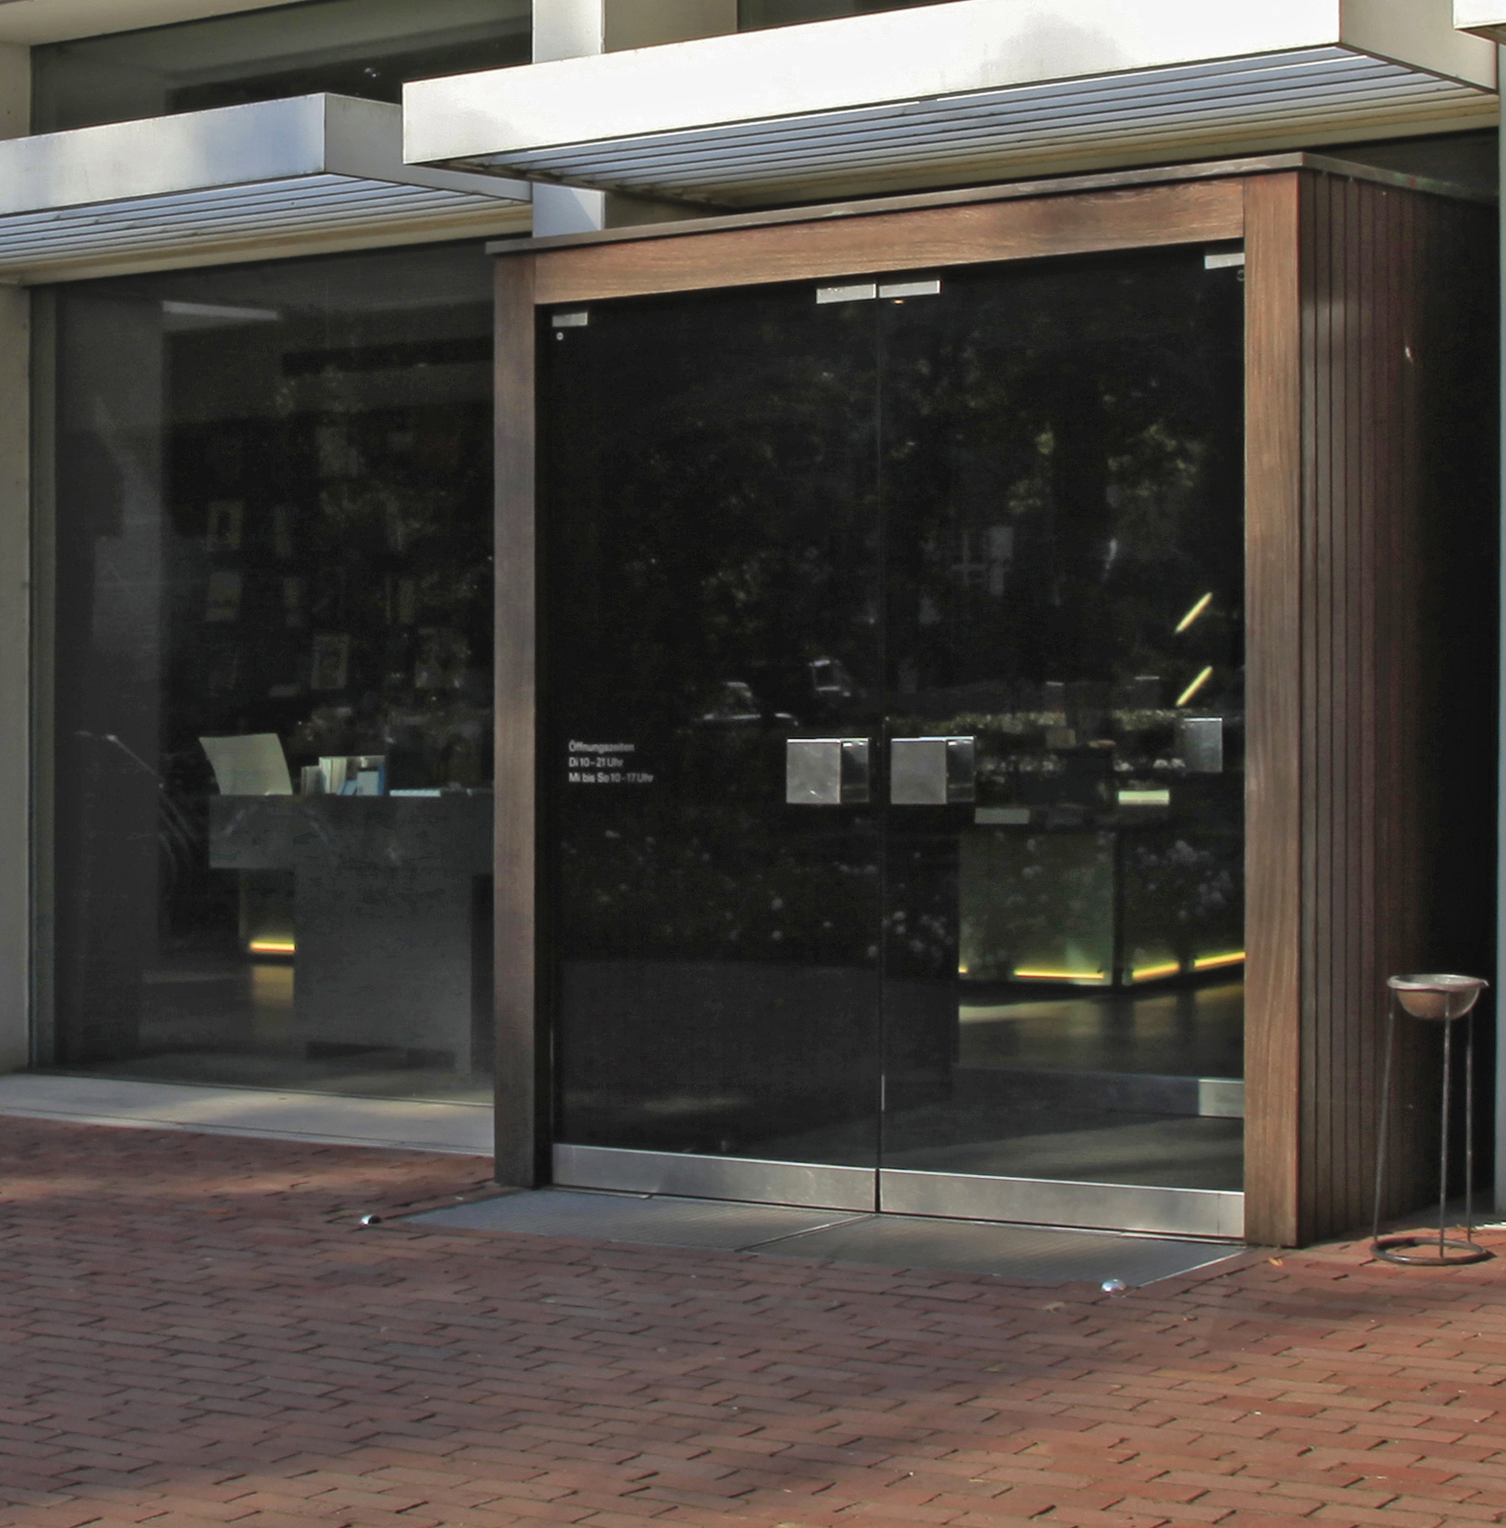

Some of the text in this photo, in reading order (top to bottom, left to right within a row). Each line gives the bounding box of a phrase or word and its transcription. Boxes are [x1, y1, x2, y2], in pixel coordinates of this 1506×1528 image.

[568, 739, 635, 754] Öffnungszeiten
[568, 757, 579, 767] Di
[580, 757, 590, 767] 10
[596, 757, 606, 767] 21
[607, 757, 624, 767] Uhr
[568, 772, 581, 782] Mi
[582, 772, 595, 782] bis
[597, 772, 610, 782] So
[610, 772, 621, 782] 10
[627, 772, 636, 782] 17
[637, 772, 654, 782] Uhr
